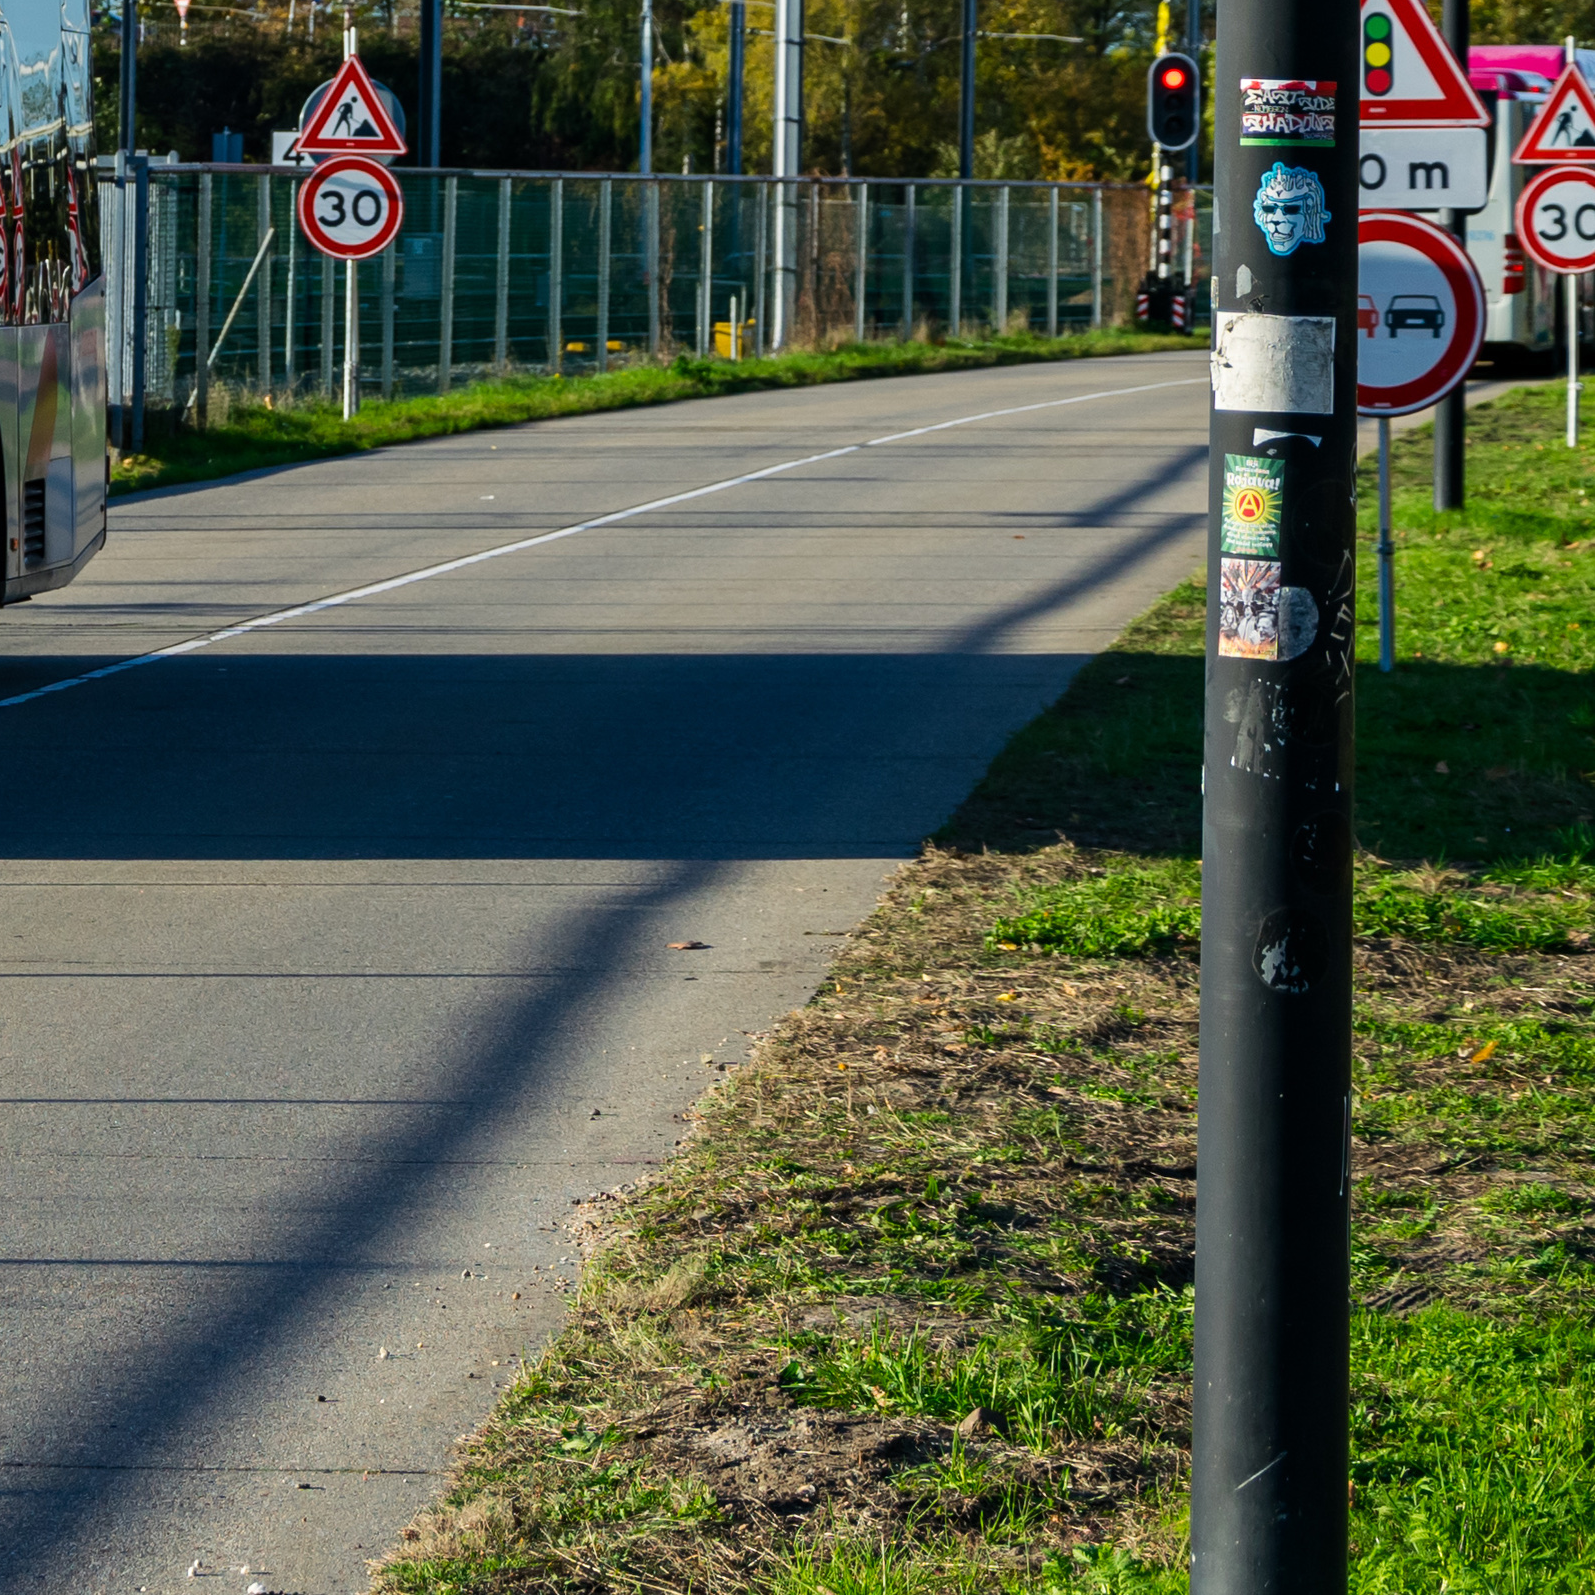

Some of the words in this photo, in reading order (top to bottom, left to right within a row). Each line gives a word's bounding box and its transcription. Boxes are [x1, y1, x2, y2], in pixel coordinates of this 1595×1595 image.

[1409, 161, 1449, 189] m
[318, 190, 382, 227] 30
[1539, 204, 1595, 241] 30
